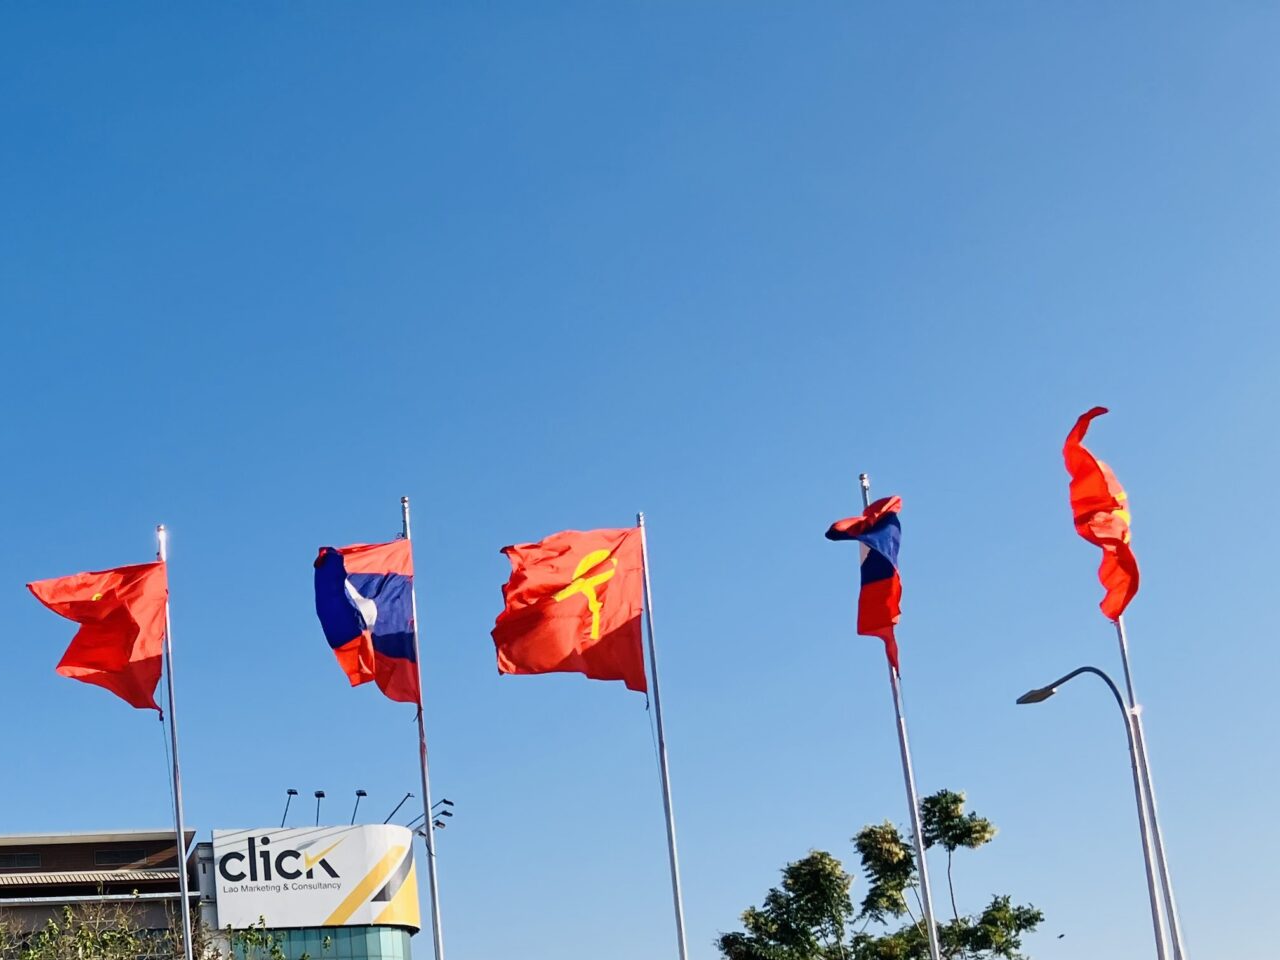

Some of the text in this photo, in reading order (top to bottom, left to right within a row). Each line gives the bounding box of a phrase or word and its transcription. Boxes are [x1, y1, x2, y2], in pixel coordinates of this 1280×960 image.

[219, 836, 343, 882] click
[223, 882, 342, 893] Lao Marketing & Consultancy
